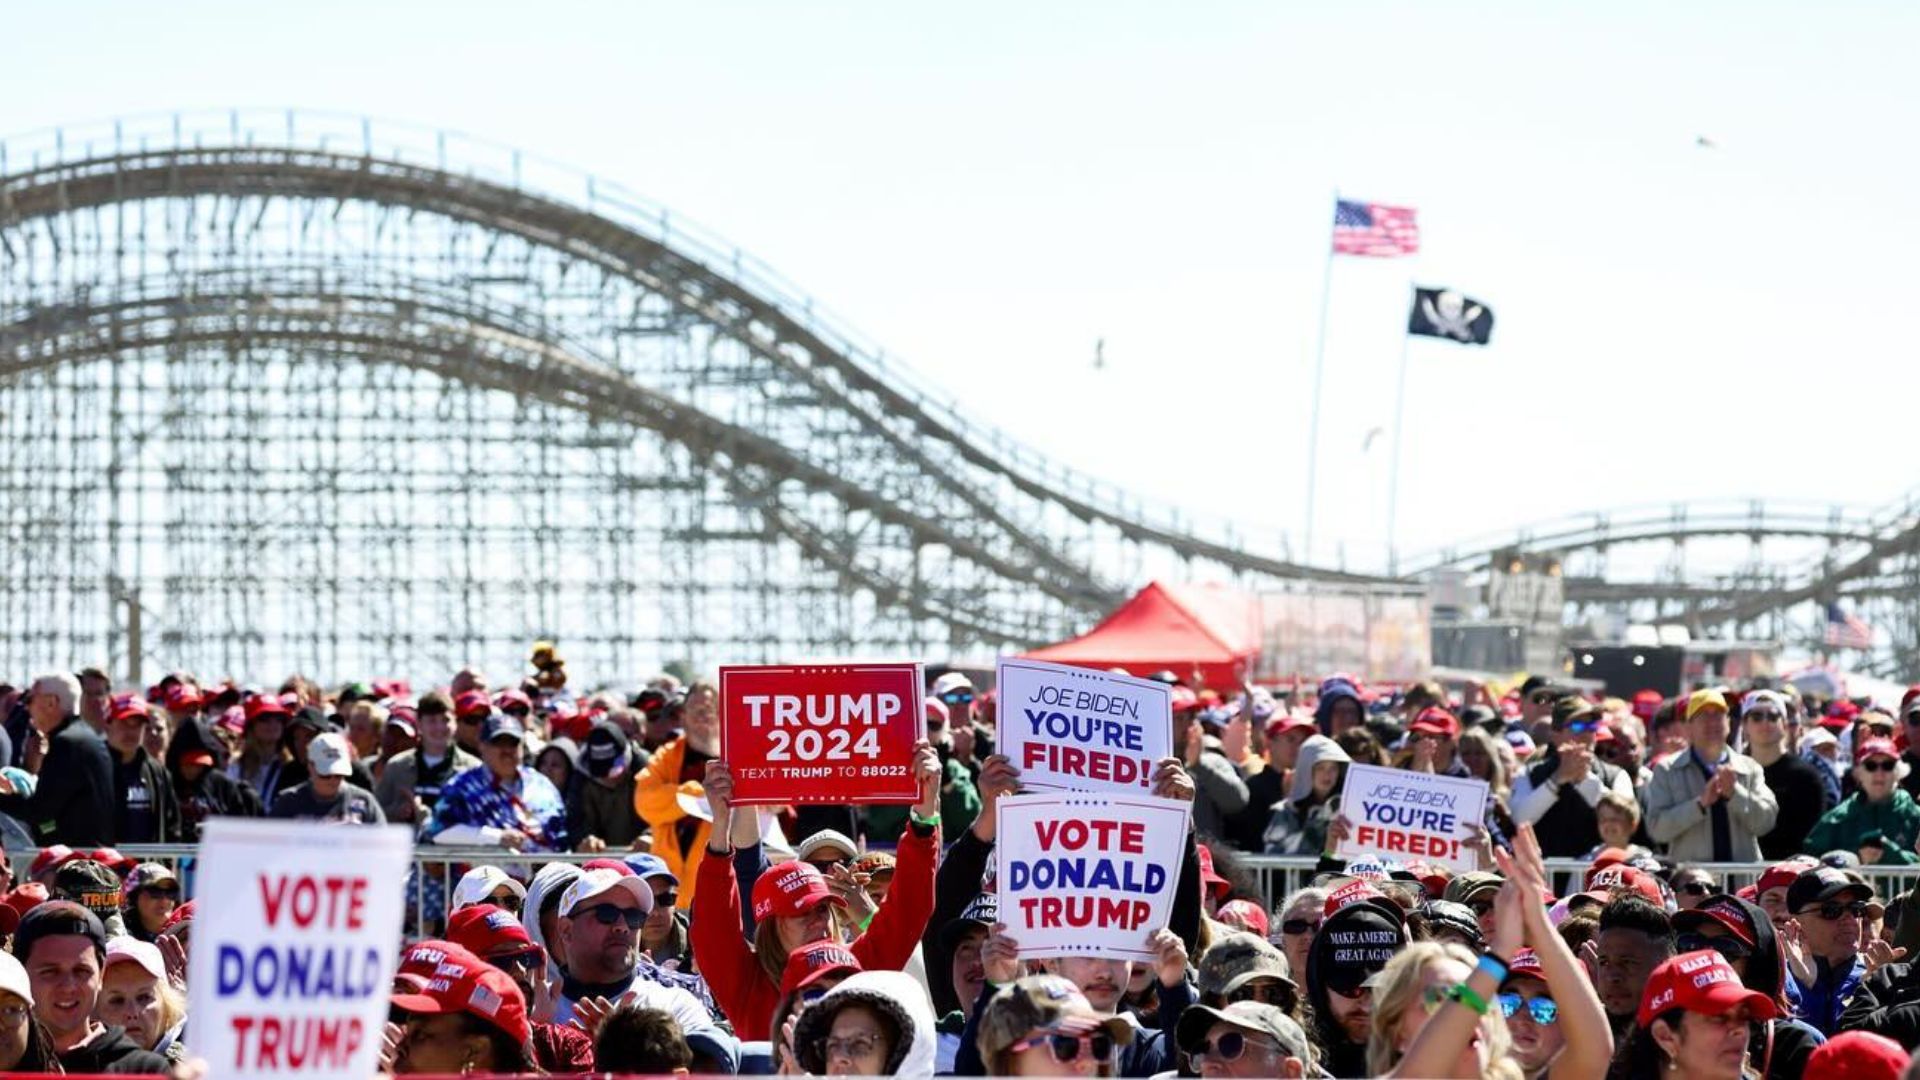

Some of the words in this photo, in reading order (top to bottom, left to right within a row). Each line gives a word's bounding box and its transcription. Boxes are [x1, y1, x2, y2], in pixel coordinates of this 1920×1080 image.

[742, 693, 901, 727] TRUMP
[1030, 685, 1075, 707] JOE
[1076, 691, 1139, 720] BIDEN,
[766, 728, 881, 761] 2024
[1023, 708, 1143, 751] YOU'RE
[740, 767, 776, 779] TEXT
[782, 766, 832, 778] TRUMP
[838, 766, 856, 778] TO
[861, 765, 907, 777] 88022
[1023, 741, 1151, 788] FIRED!
[1368, 784, 1404, 801] JOE
[1403, 788, 1458, 810] BIDEN,
[1362, 801, 1456, 833] YOU'RE
[1034, 819, 1145, 854] VOTE
[1357, 826, 1461, 860] FIRED!
[1010, 858, 1166, 894] DONALD
[259, 875, 368, 931] VOTE
[1019, 896, 1151, 931] TRUMP
[1330, 932, 1356, 944] MAKE
[1335, 949, 1363, 961] GREAT
[217, 944, 380, 998] DONALD
[231, 1016, 365, 1070] TRUMP
